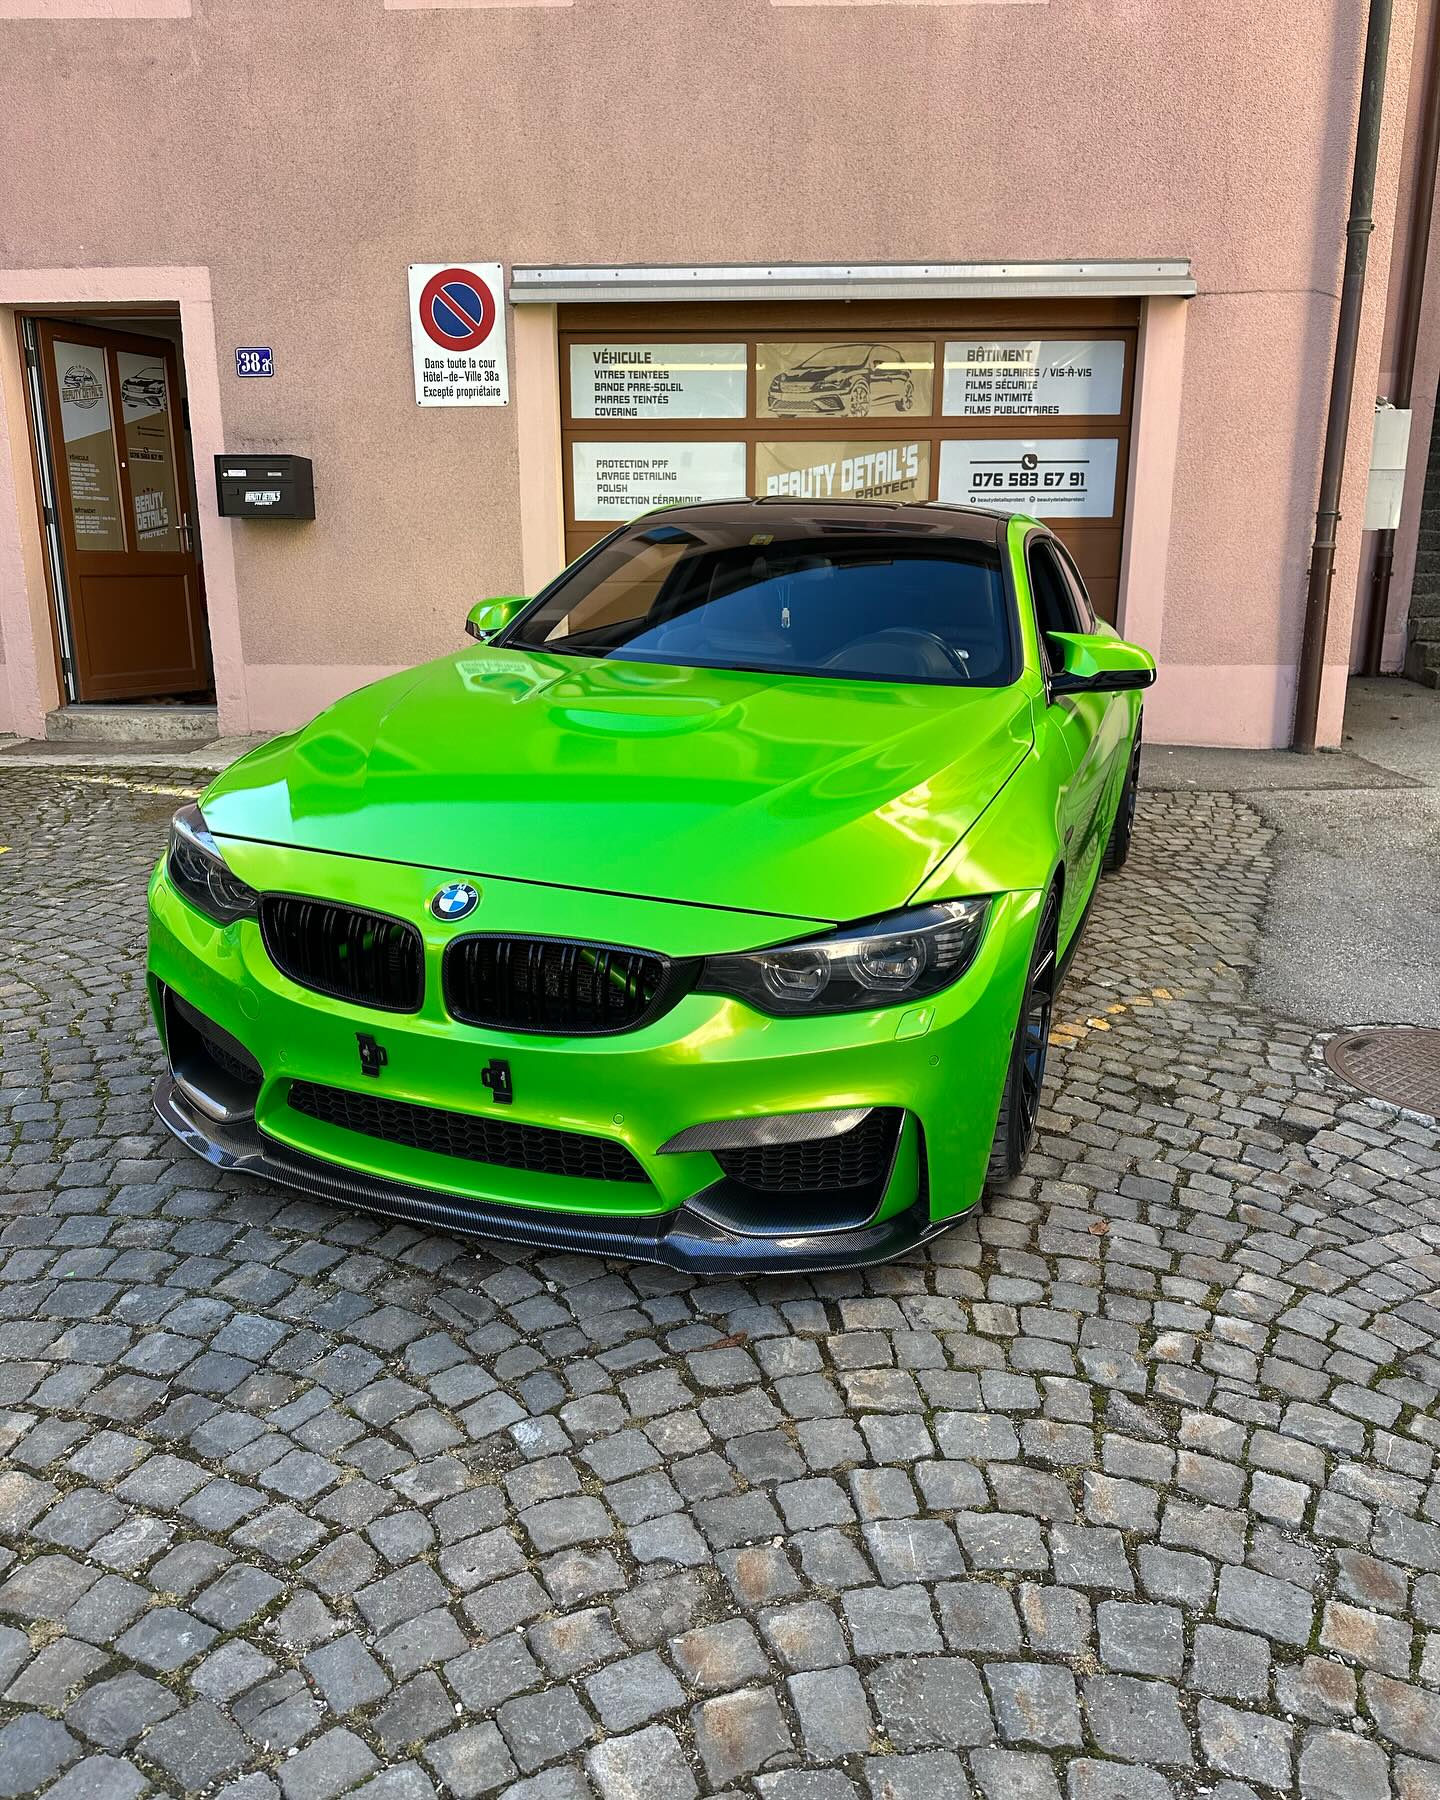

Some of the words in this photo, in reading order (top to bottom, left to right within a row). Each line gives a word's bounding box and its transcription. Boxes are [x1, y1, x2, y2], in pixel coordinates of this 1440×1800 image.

[592, 348, 652, 364] VÉHICULE
[967, 346, 1033, 362] BÂTIMENT
[240, 352, 270, 372] 38a
[424, 357, 444, 369] Dans
[447, 357, 467, 369] toute
[468, 357, 476, 369] la
[478, 359, 496, 369] cour
[423, 371, 482, 382] Hôtel-de-Ville
[484, 370, 500, 382] 38a
[594, 370, 626, 380] VITRES
[966, 368, 994, 377] FILMS
[995, 368, 1040, 377] SOLAIRES
[1042, 368, 1048, 378] /
[1049, 365, 1092, 377] VIS-À-VIS
[594, 382, 625, 392] BANDE
[627, 382, 684, 392] PARE-SOLEIL
[965, 380, 993, 390] FILMS
[423, 385, 454, 400] Excepté
[456, 384, 501, 400] propriétaire
[964, 393, 992, 402] FILMS
[994, 391, 1033, 402] INTIMITÉ
[594, 395, 631, 404] PHARES
[632, 393, 669, 404] TEINTÉS
[594, 407, 638, 417] COVERING
[964, 405, 991, 415] FILMS
[993, 405, 1060, 415] PUBLICITAIRES
[596, 459, 649, 468] PROTECTION
[652, 459, 669, 468] PPF
[841, 444, 918, 493] DETAIL'S
[596, 471, 631, 481] LAVAGE
[633, 471, 677, 481] DETAILING
[972, 472, 1003, 487] 076
[1008, 472, 1038, 486] 583
[1044, 472, 1065, 486] 67
[1069, 472, 1085, 486] 91
[597, 483, 628, 493] POLISH
[855, 478, 918, 499] PROTECT
[134, 491, 164, 513] BEAUTY
[597, 495, 650, 505] PROTECTION
[137, 508, 169, 532] DETAIL'S
